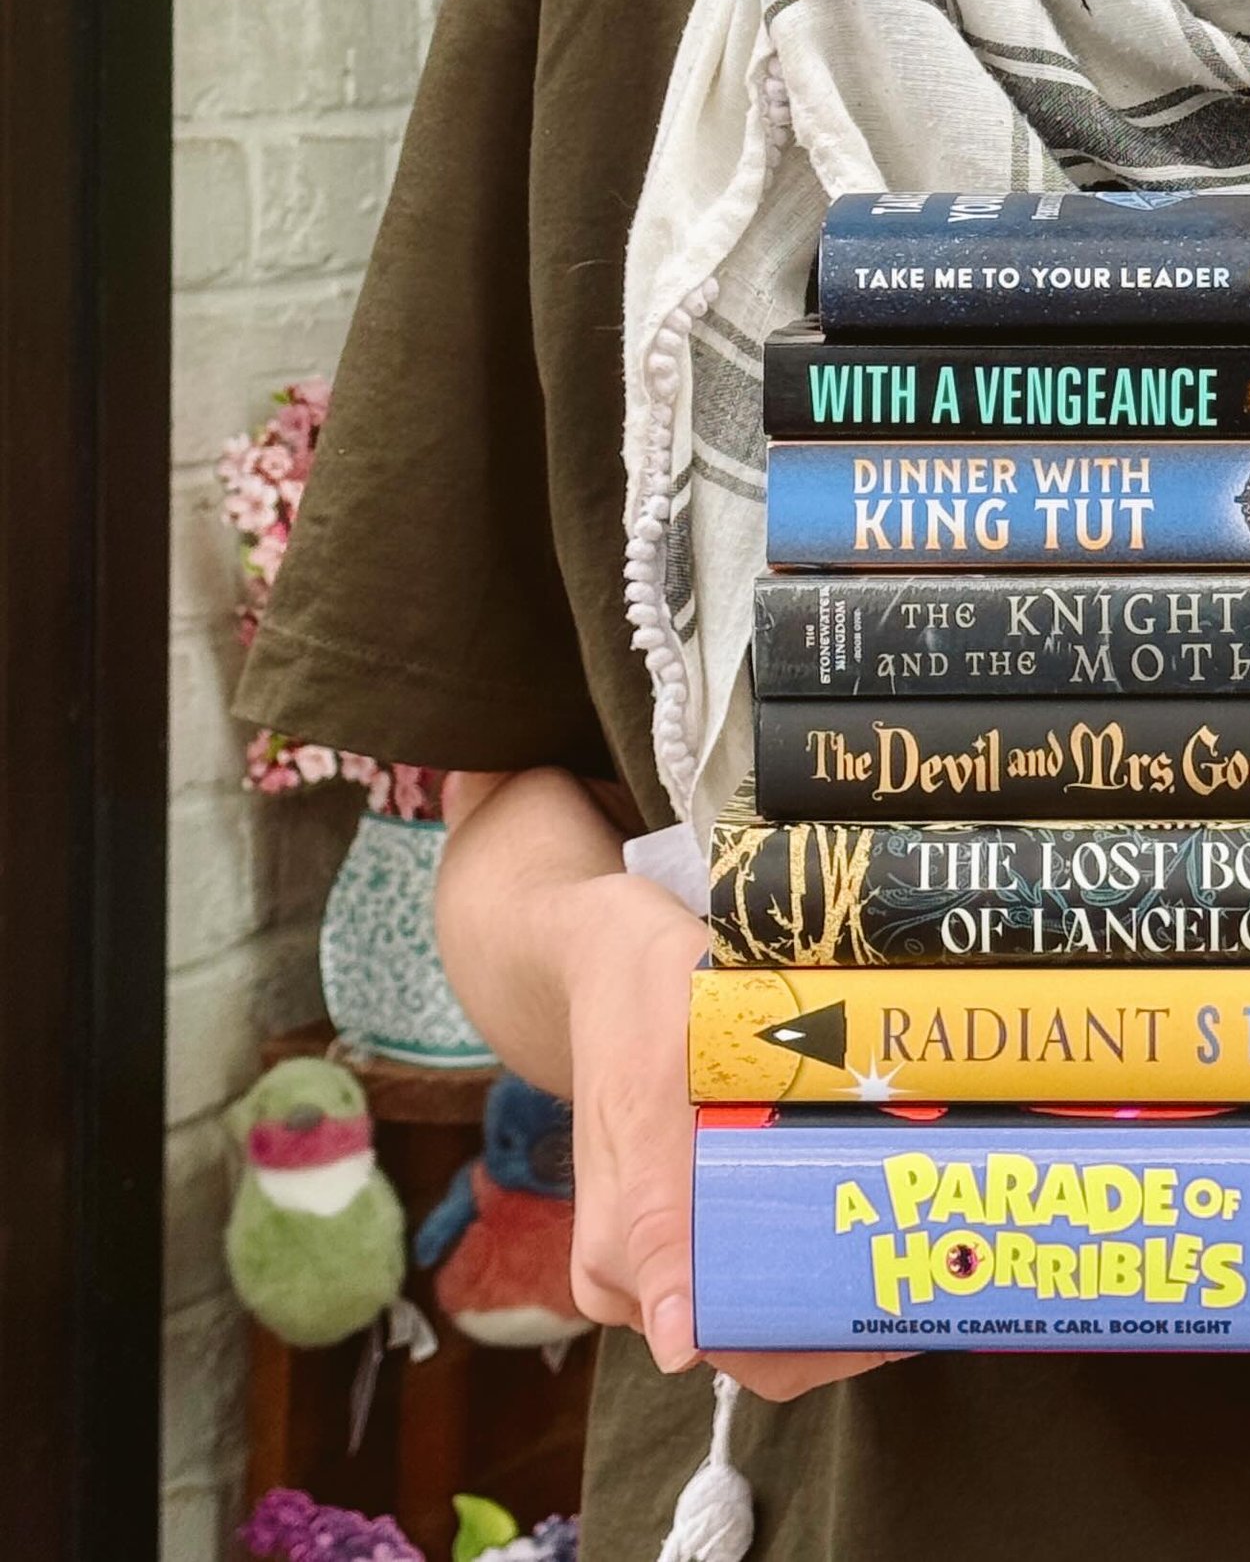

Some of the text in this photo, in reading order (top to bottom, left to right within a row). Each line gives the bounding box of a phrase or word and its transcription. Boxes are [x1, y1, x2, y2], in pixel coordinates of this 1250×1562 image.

[854, 267, 925, 290] TAKE
[935, 267, 972, 289] ME
[981, 267, 1019, 289] TO
[1030, 267, 1110, 289] YOUR
[1120, 267, 1230, 289] LEADER
[809, 365, 916, 424] WITH
[932, 366, 960, 424] A
[974, 366, 1218, 426] VENGEANCE
[853, 458, 1151, 494] DINNER WITH
[853, 497, 1155, 551] KING TUT
[819, 586, 831, 684] STONEWATER
[834, 599, 846, 672] KINGDOM
[901, 588, 1248, 637] THE KNIGHT
[965, 650, 1037, 676] THE
[807, 730, 874, 783] The
[871, 720, 1000, 801] Devil
[1007, 731, 1063, 780] and
[906, 842, 1018, 891] THE
[1041, 842, 1179, 891] LOST
[940, 907, 1008, 954] OF
[881, 1006, 1170, 1063] RADIANT
[835, 1151, 1242, 1235] A PARADE OF
[870, 1229, 1248, 1317] HORRIBLES
[852, 1319, 1232, 1334] DUNGEON CRAWLER CARL BOOK EIGHT
